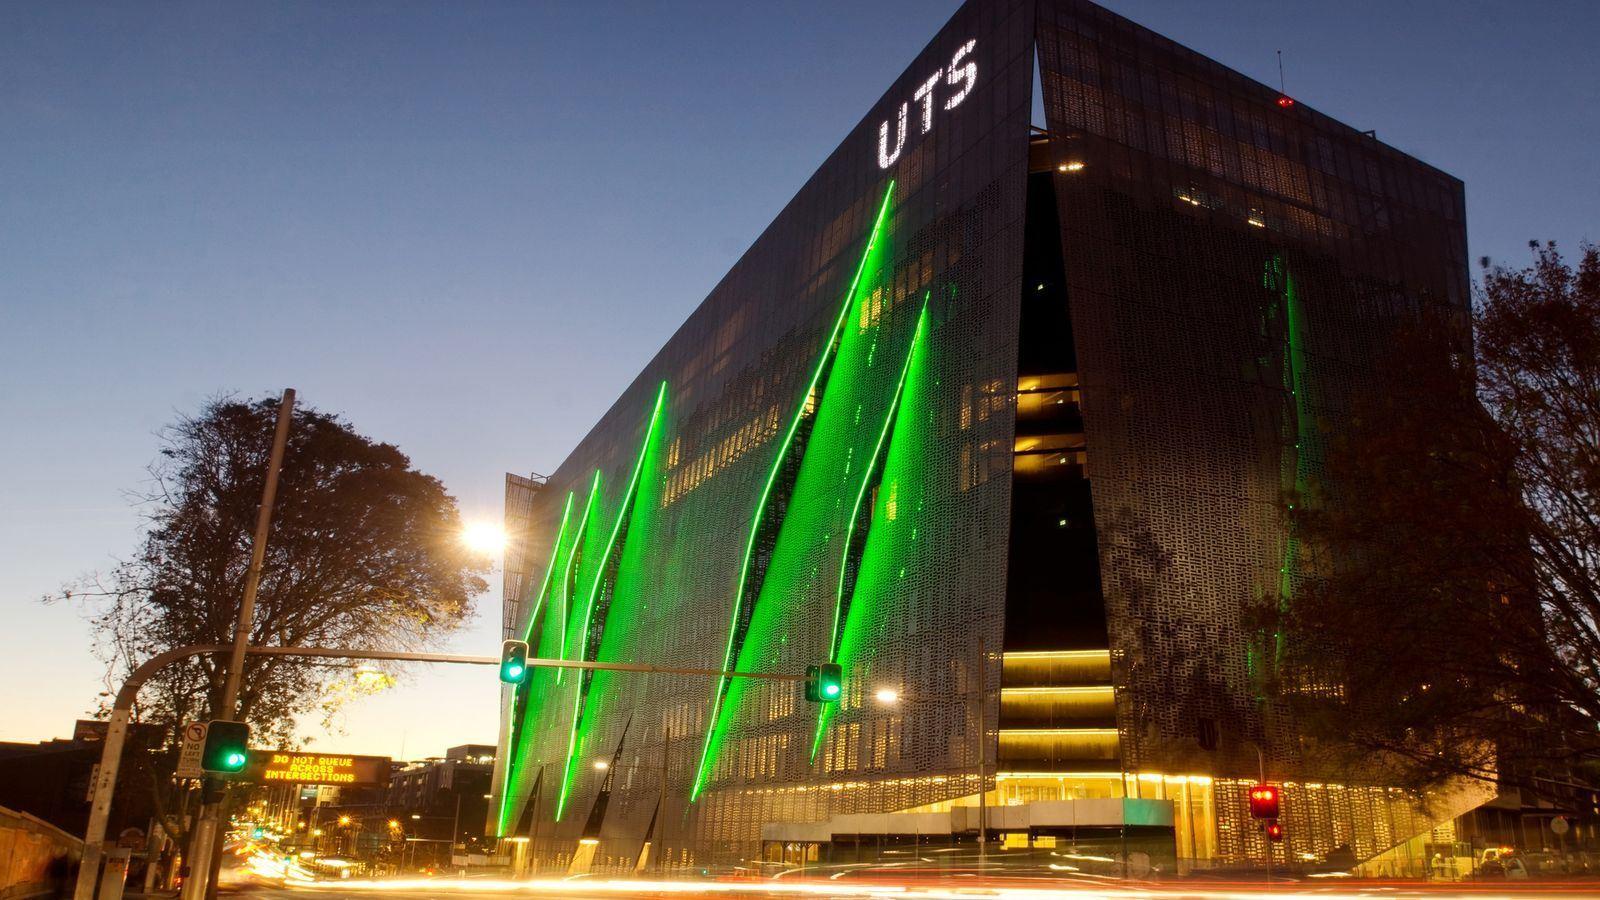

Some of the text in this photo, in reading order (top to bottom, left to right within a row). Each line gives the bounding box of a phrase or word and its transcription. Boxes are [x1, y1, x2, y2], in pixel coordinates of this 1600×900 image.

[878, 39, 977, 169] UTS
[273, 755, 353, 767] DO NOT QUEUE
[289, 764, 334, 773] ACROSS
[264, 770, 355, 782] INTERSECTIONS
